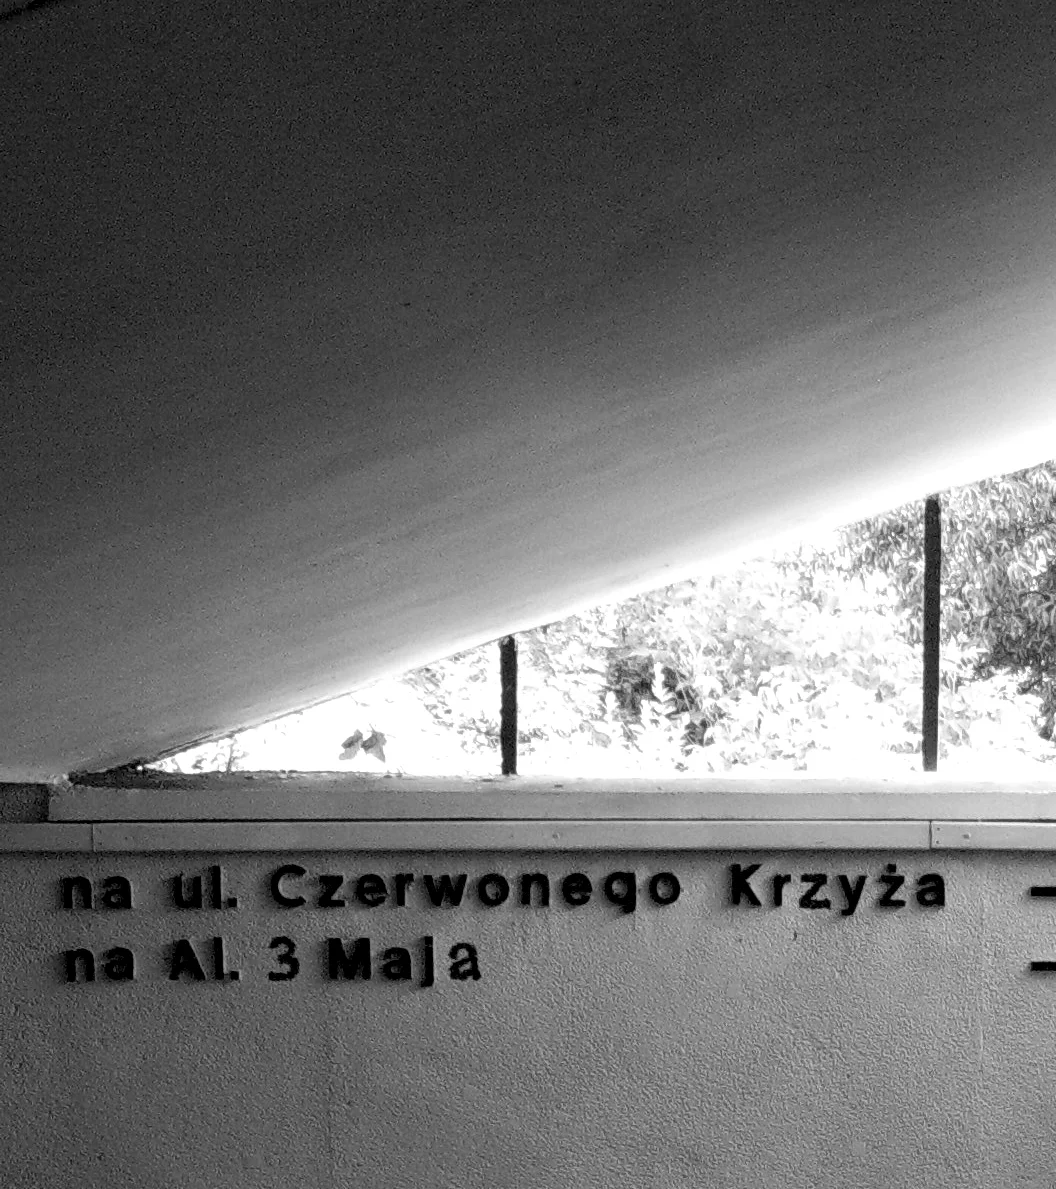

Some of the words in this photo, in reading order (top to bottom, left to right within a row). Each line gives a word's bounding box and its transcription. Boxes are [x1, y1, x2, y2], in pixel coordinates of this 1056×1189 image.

[62, 874, 132, 909] na
[175, 866, 238, 909] ul.
[271, 864, 682, 914] Czerwonego
[729, 862, 947, 916] Krzyża
[65, 946, 135, 982] na
[169, 936, 240, 981] Al.
[267, 936, 300, 981] 3
[327, 936, 481, 987] Maja
